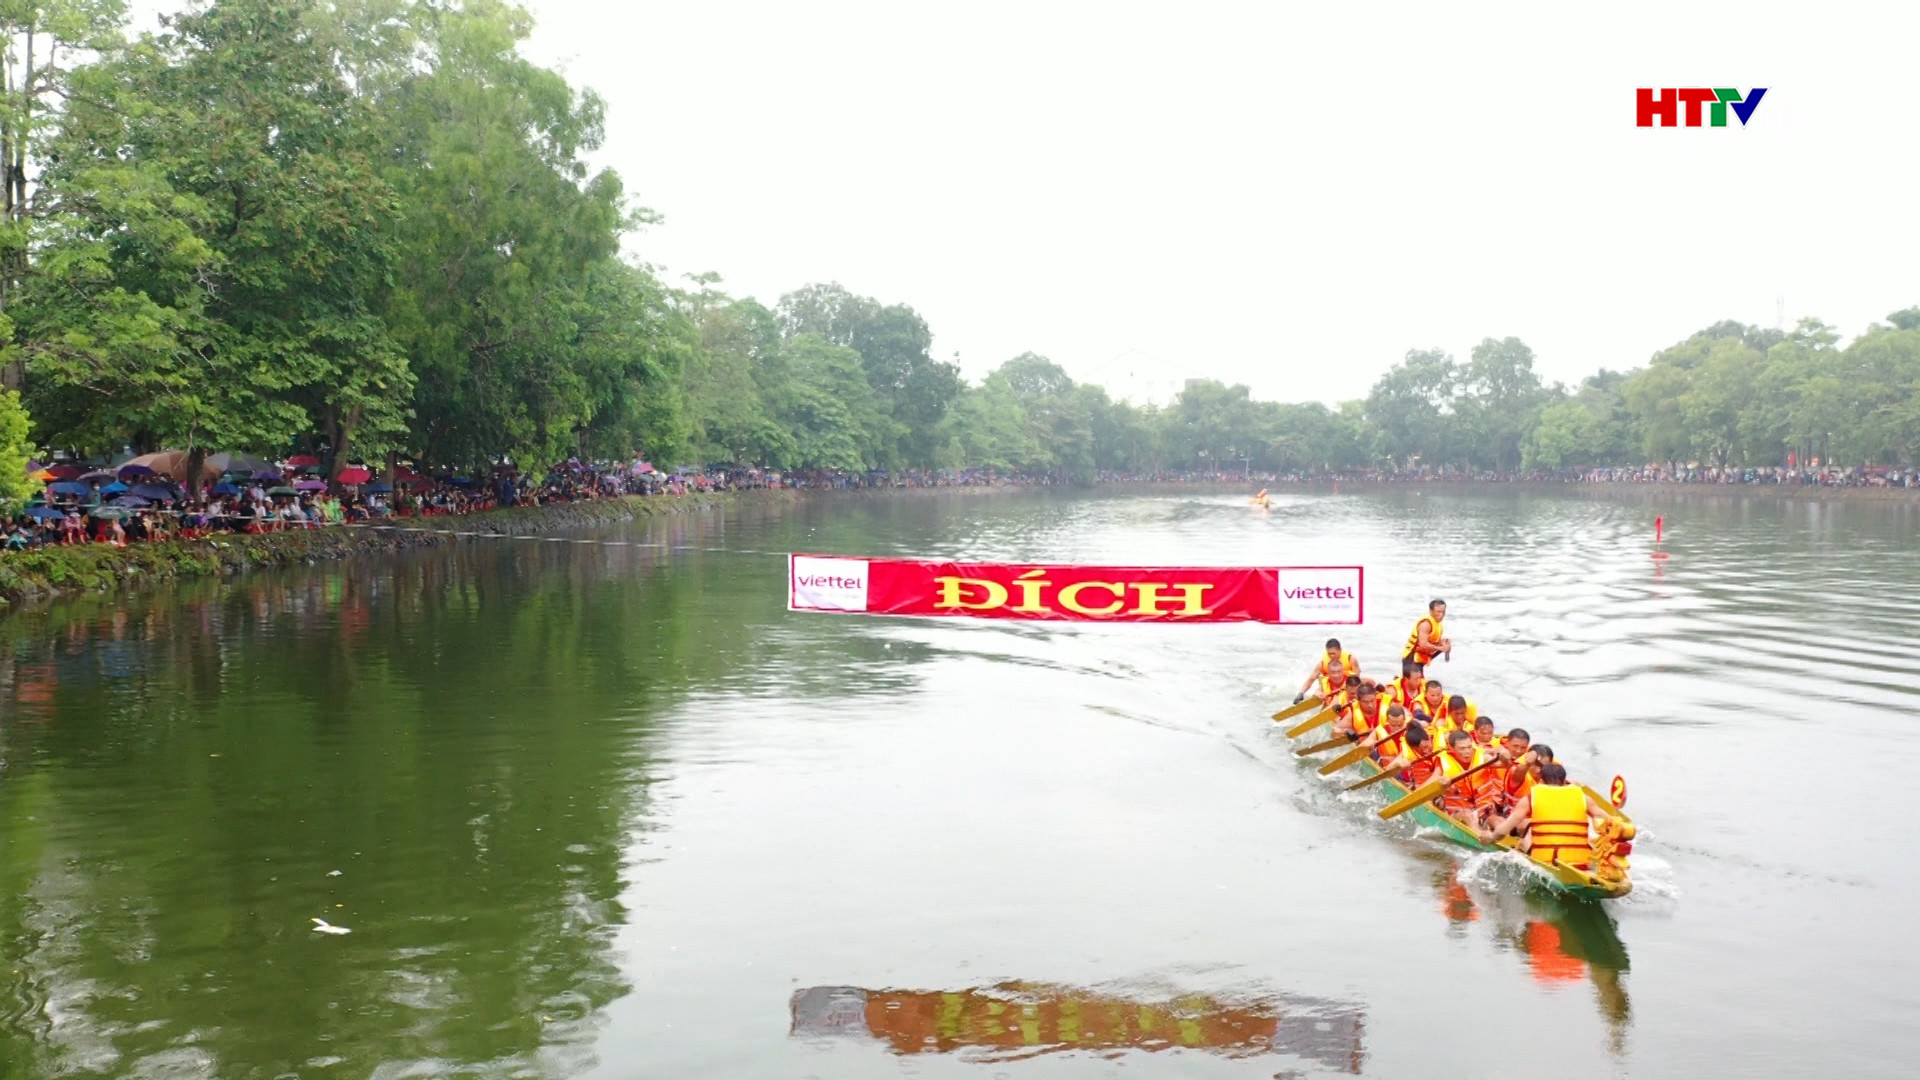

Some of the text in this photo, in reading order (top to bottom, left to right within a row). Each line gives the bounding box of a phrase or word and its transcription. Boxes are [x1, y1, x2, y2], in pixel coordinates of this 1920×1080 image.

[798, 574, 863, 589] viettel
[933, 569, 1215, 615] ĐÍCH
[1283, 586, 1355, 599] viettel
[1612, 780, 1624, 803] 2
